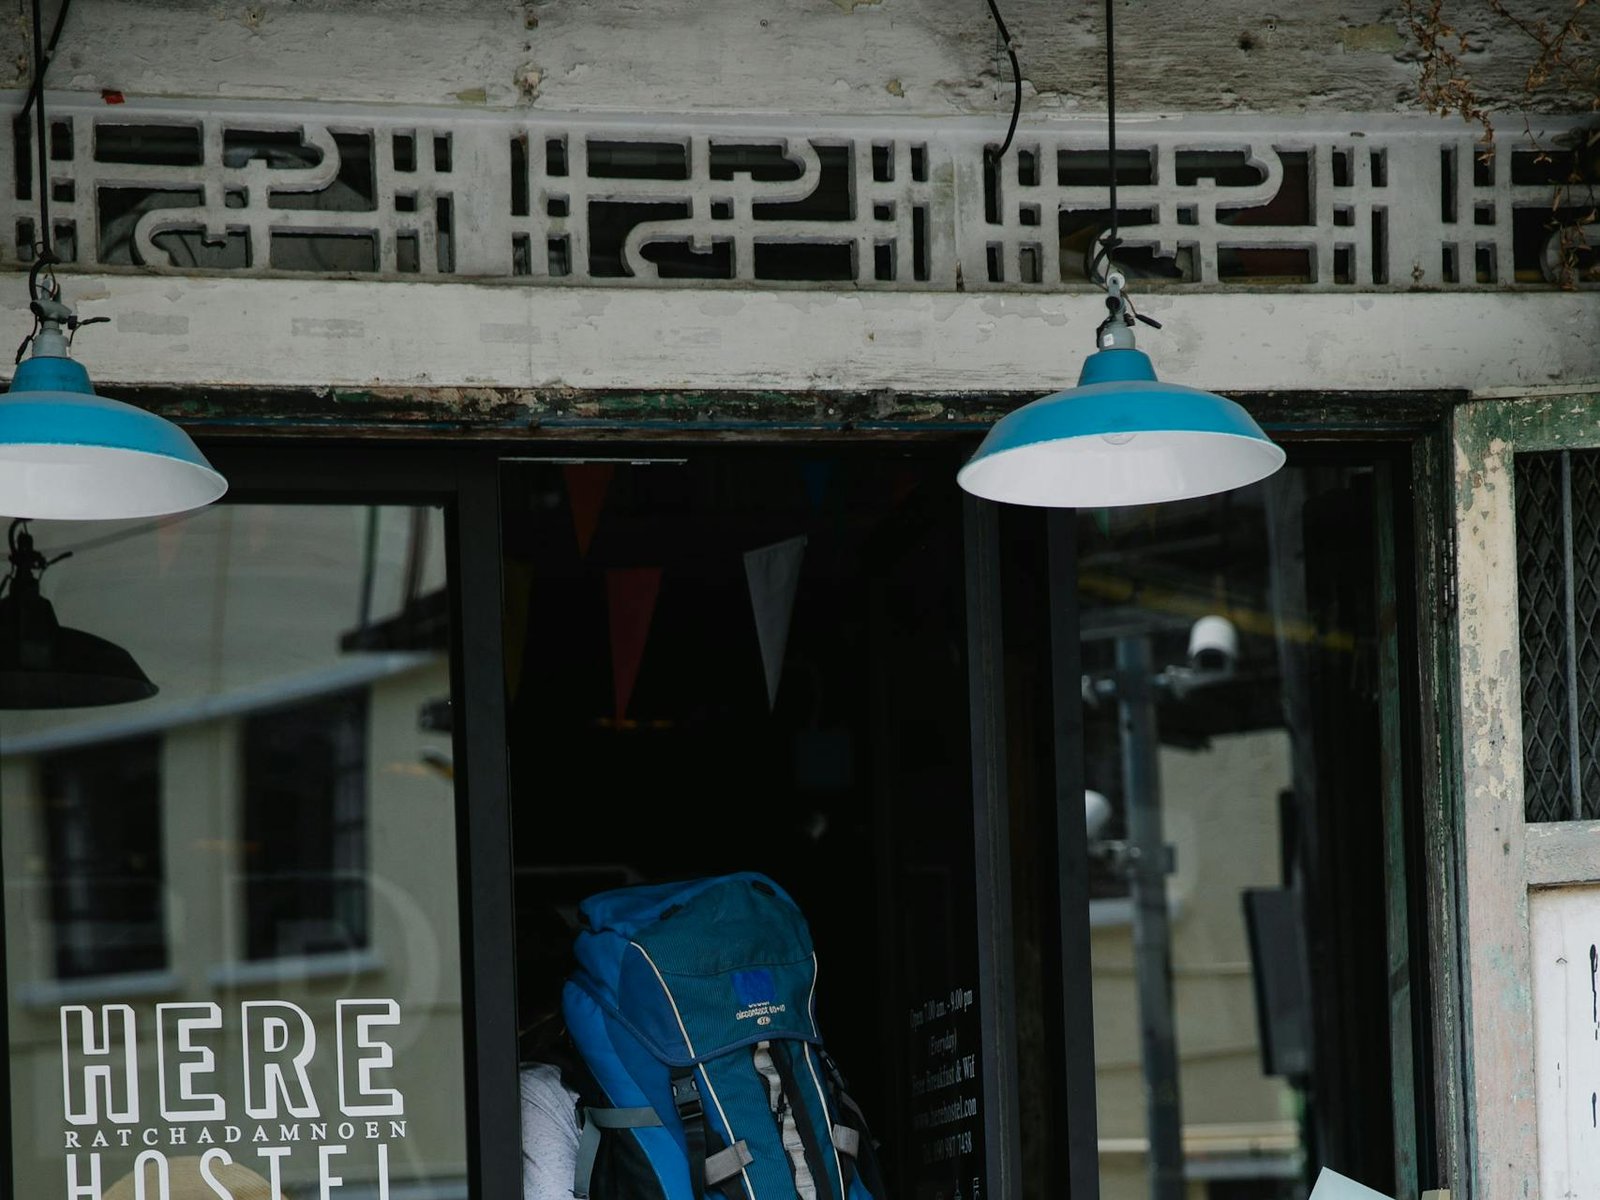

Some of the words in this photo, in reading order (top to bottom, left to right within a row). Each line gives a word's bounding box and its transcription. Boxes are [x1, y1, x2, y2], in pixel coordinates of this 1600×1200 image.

[950, 987, 964, 1013] 9.00
[60, 999, 404, 1125] HERE
[955, 1058, 962, 1082] &
[64, 1120, 407, 1148] RATCHADAMNOEN
